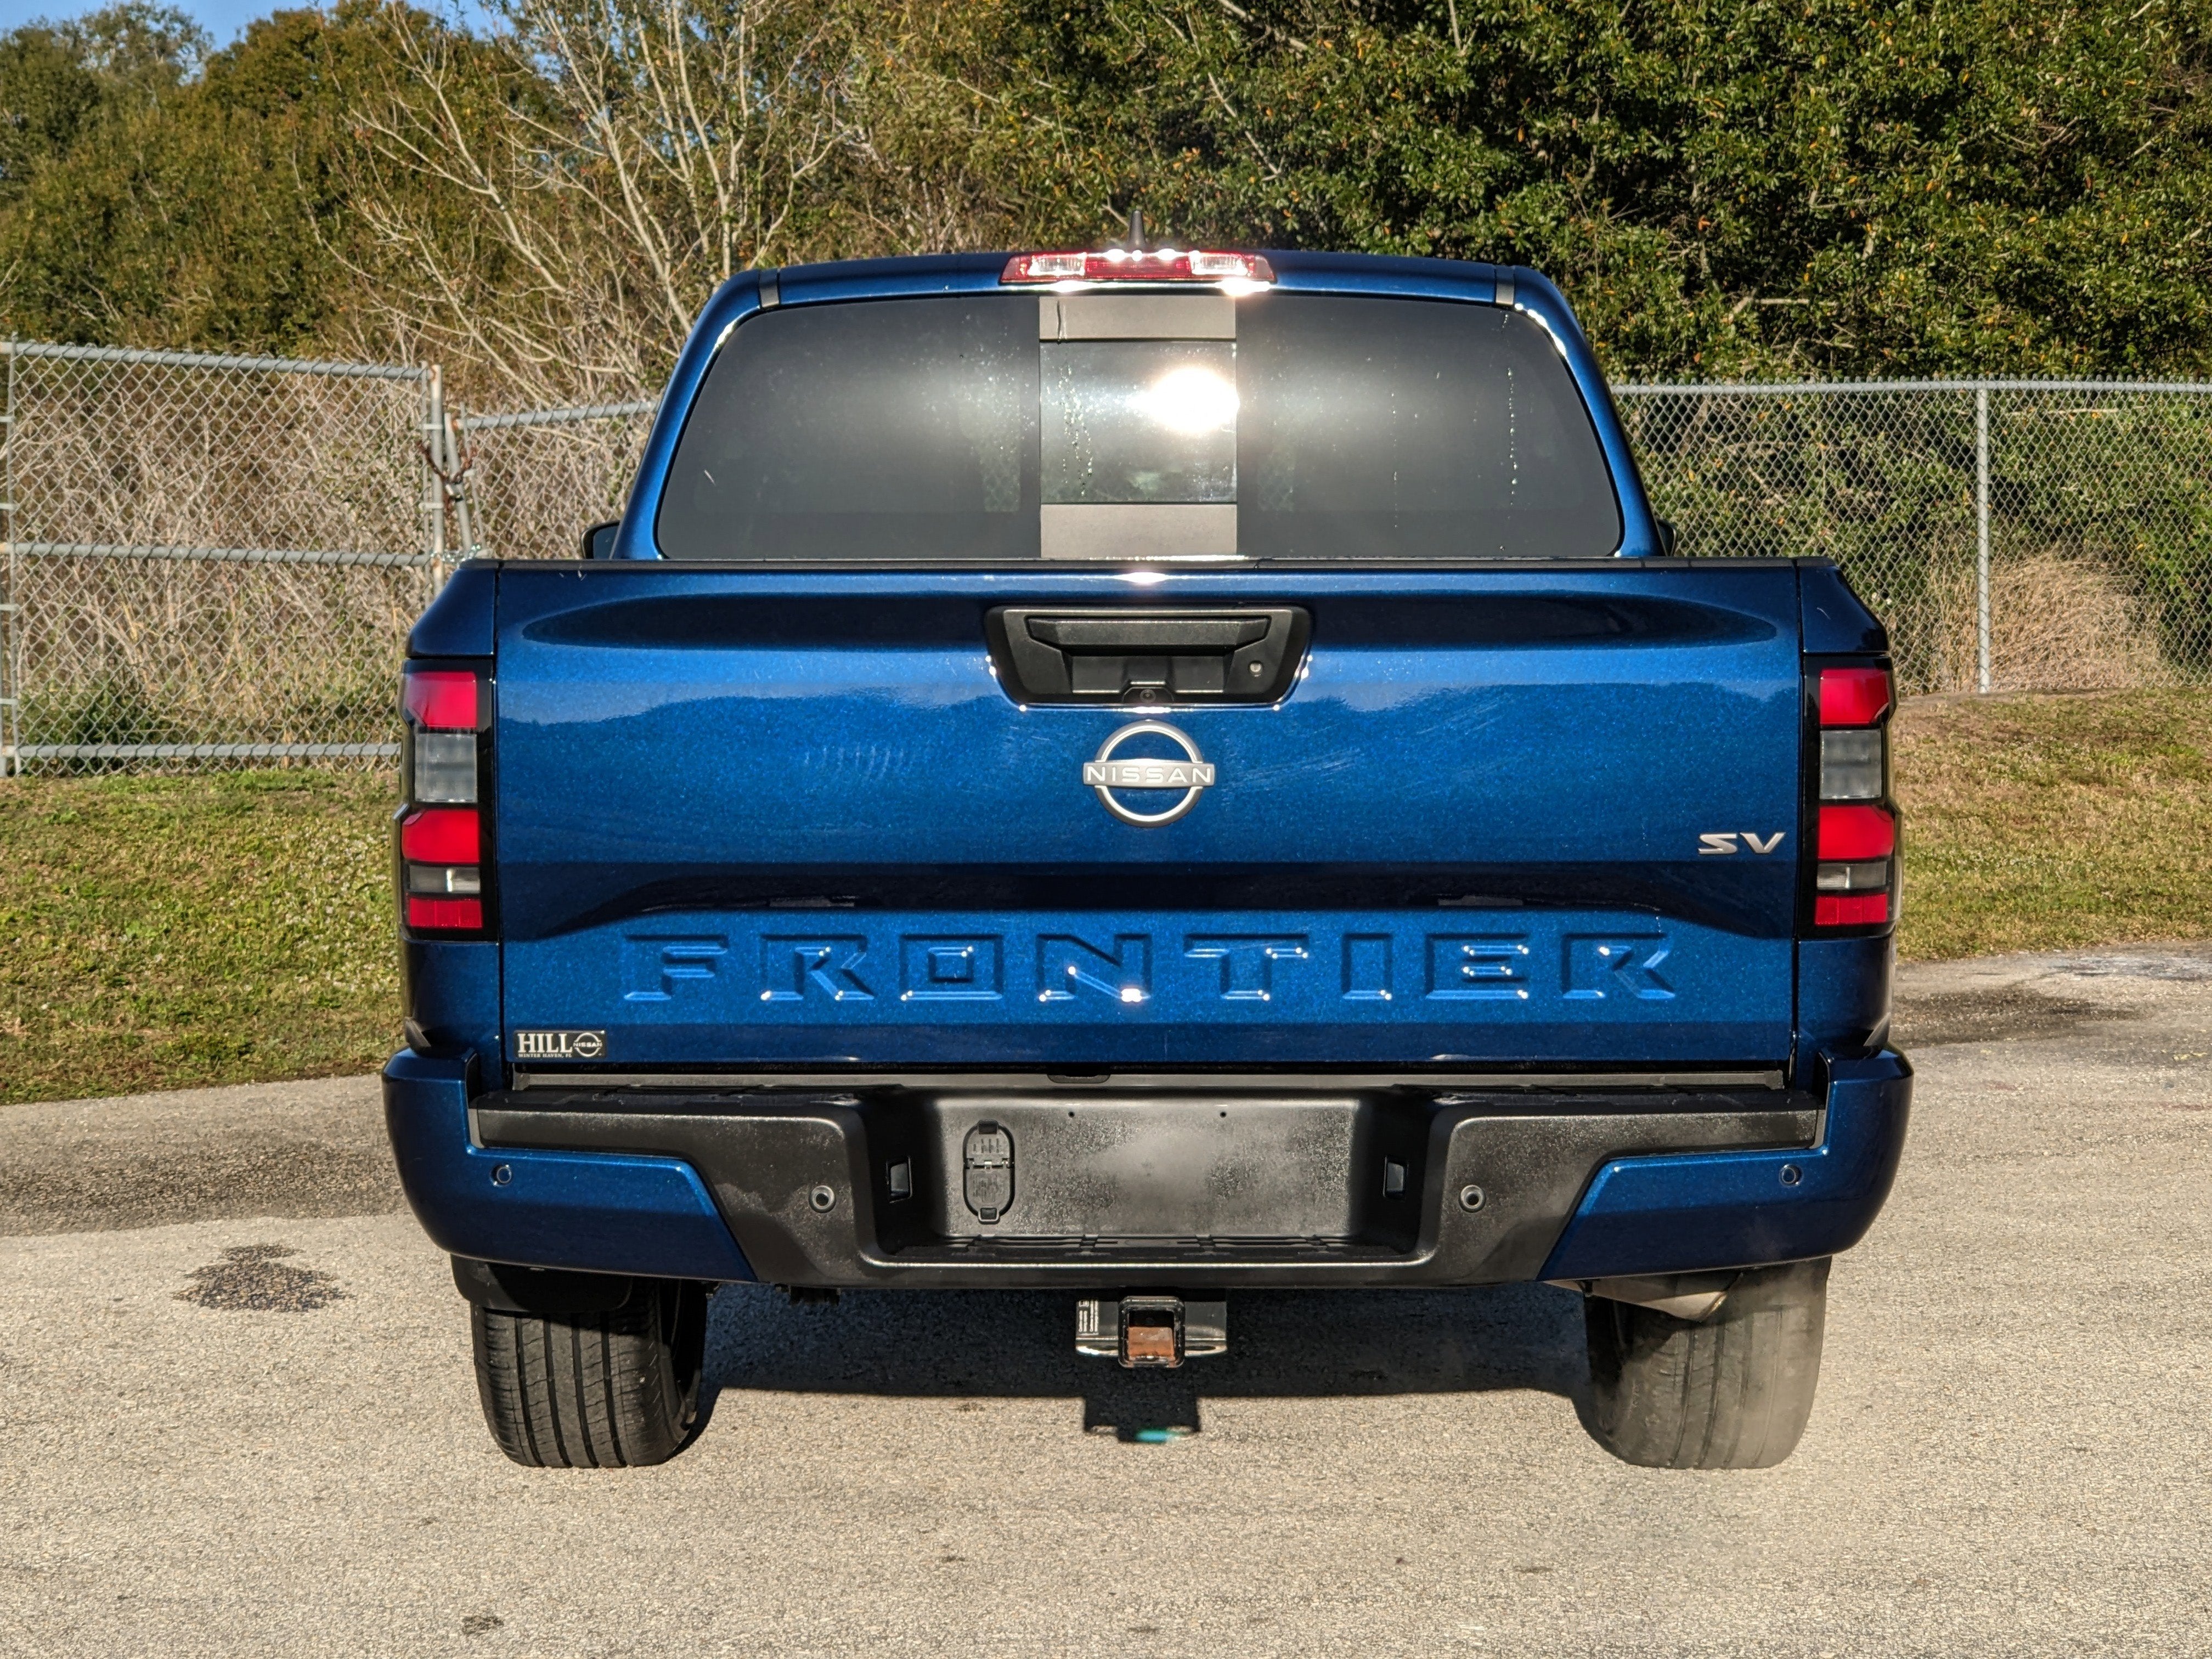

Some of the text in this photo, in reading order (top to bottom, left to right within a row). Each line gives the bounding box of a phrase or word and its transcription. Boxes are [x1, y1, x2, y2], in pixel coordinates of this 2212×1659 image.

[1087, 766, 1211, 783] NISSAN
[1698, 832, 1786, 854] SV
[623, 933, 1677, 1002] FRONTIER
[517, 1033, 573, 1053] HILL
